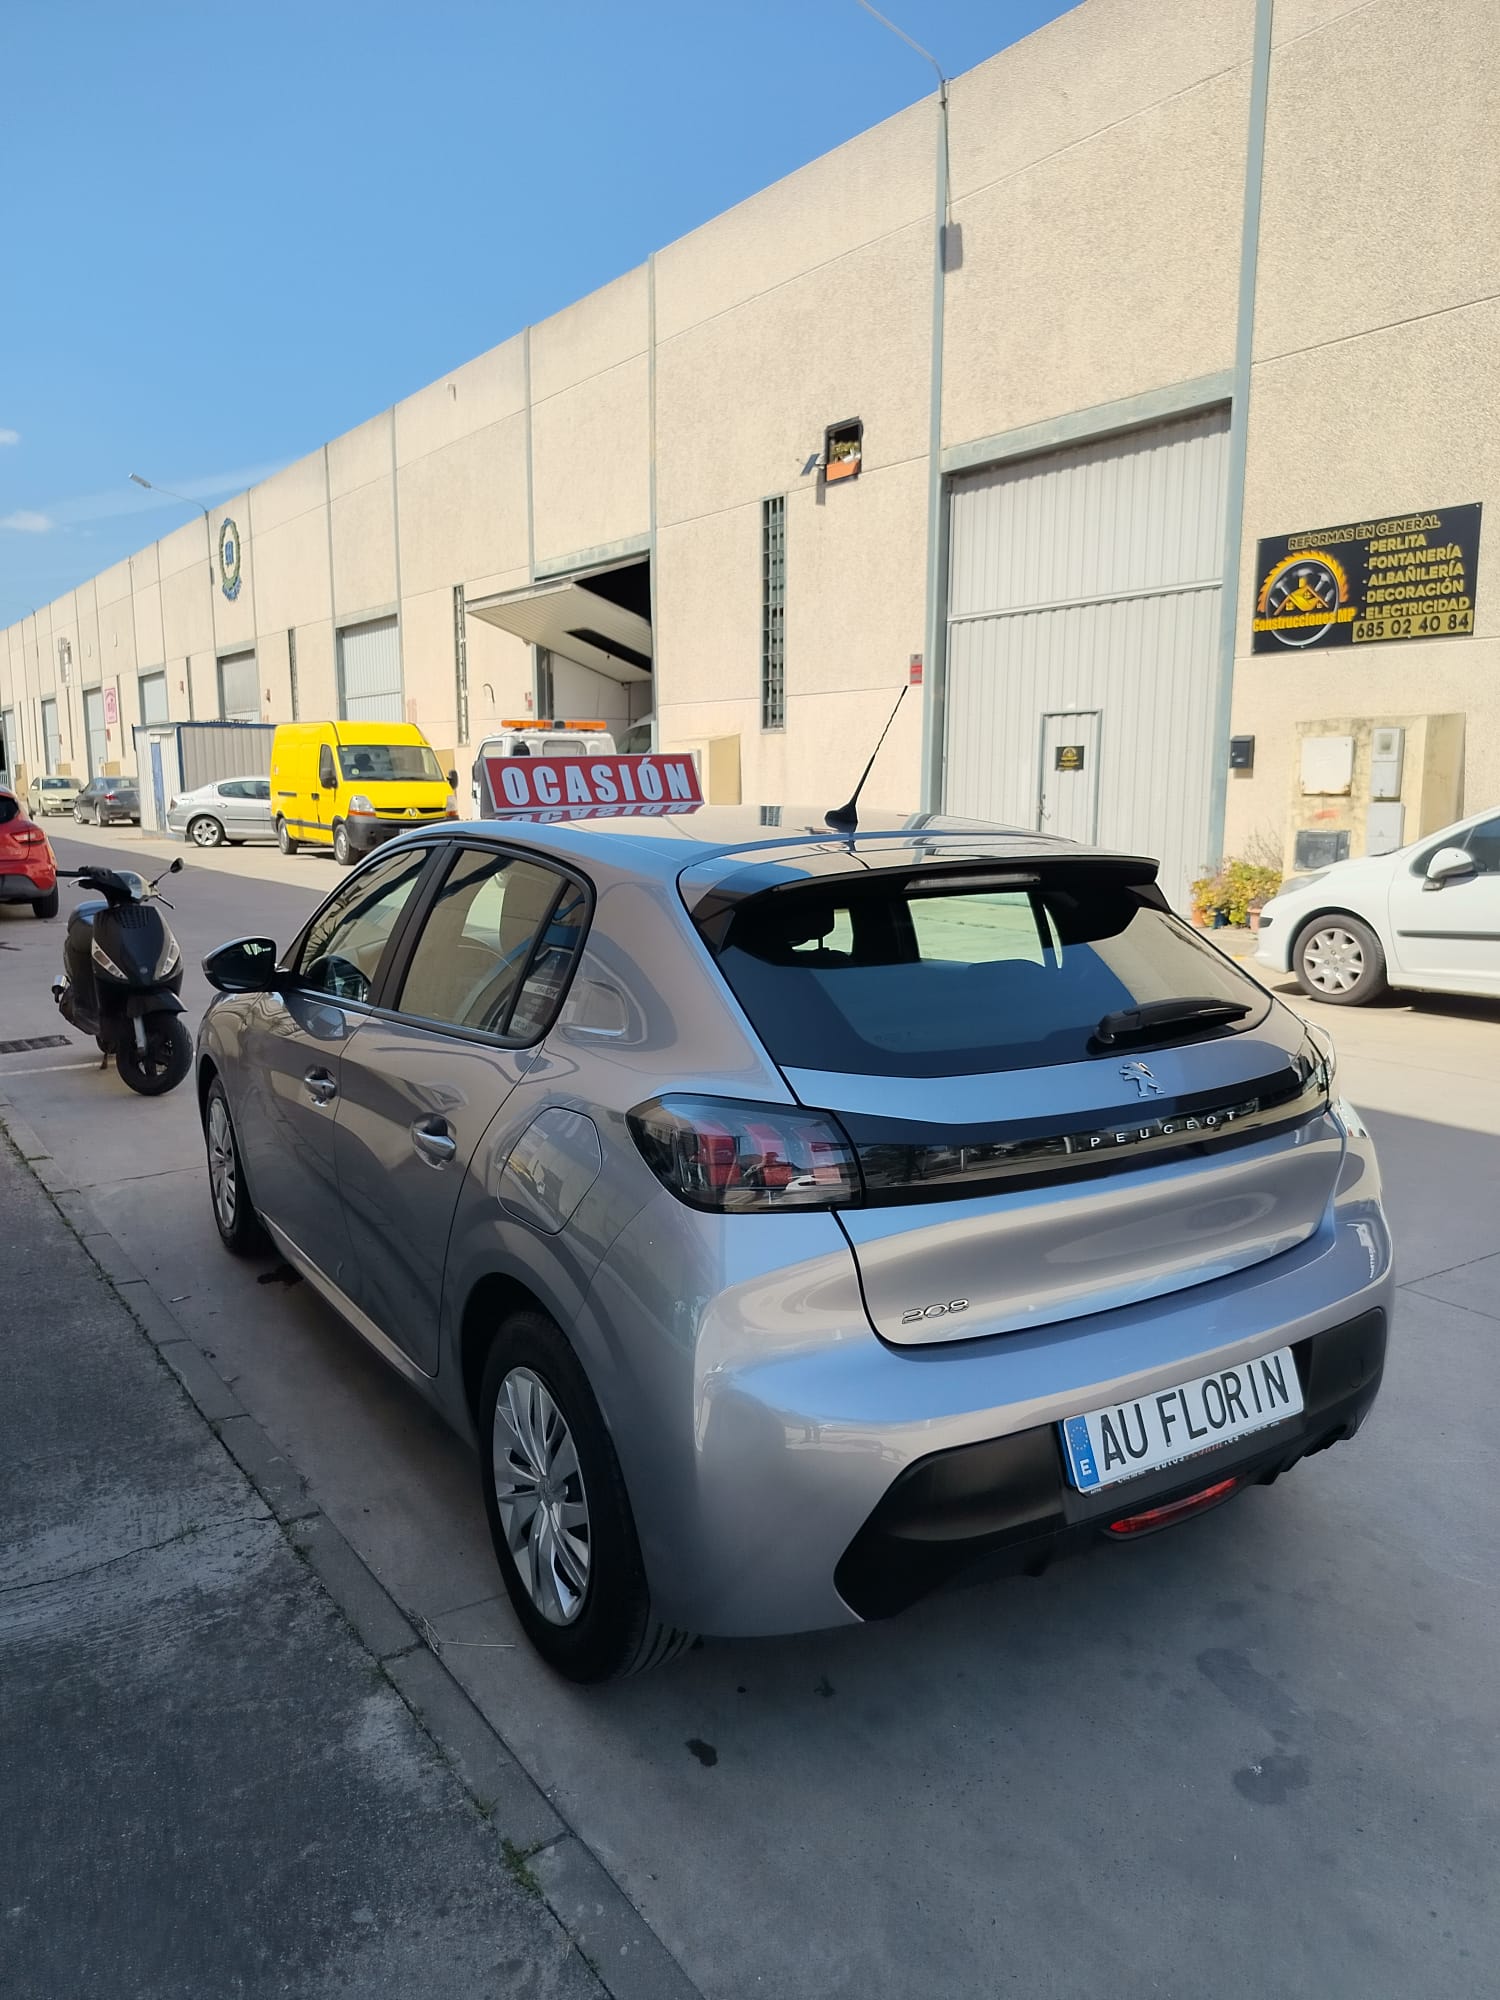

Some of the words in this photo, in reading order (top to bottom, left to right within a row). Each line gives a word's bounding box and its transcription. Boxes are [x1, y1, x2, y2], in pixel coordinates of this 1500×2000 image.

[1288, 529, 1354, 550] REFORMAS
[1356, 525, 1375, 540] EN
[1376, 514, 1441, 536] GENERAL
[1369, 533, 1427, 553] PERLITA
[1368, 543, 1462, 570] FONTANERÍA
[1368, 560, 1464, 587] ALBAÑILERÍA
[1367, 578, 1464, 603] DECORACIÓN
[1337, 607, 1357, 623] MP
[1365, 597, 1470, 620] ELECTRICIDAD
[1356, 621, 1384, 638] 685
[1391, 619, 1412, 635] 02
[1418, 616, 1441, 632] 40
[1448, 613, 1469, 630] 84
[501, 757, 692, 805] OCASIÓN
[1090, 1111, 1235, 1147] PEUGEOT
[902, 1298, 969, 1324] 208
[1080, 1458, 1092, 1476] E
[1100, 1403, 1149, 1471] AU
[1155, 1355, 1290, 1447] FLORIN
